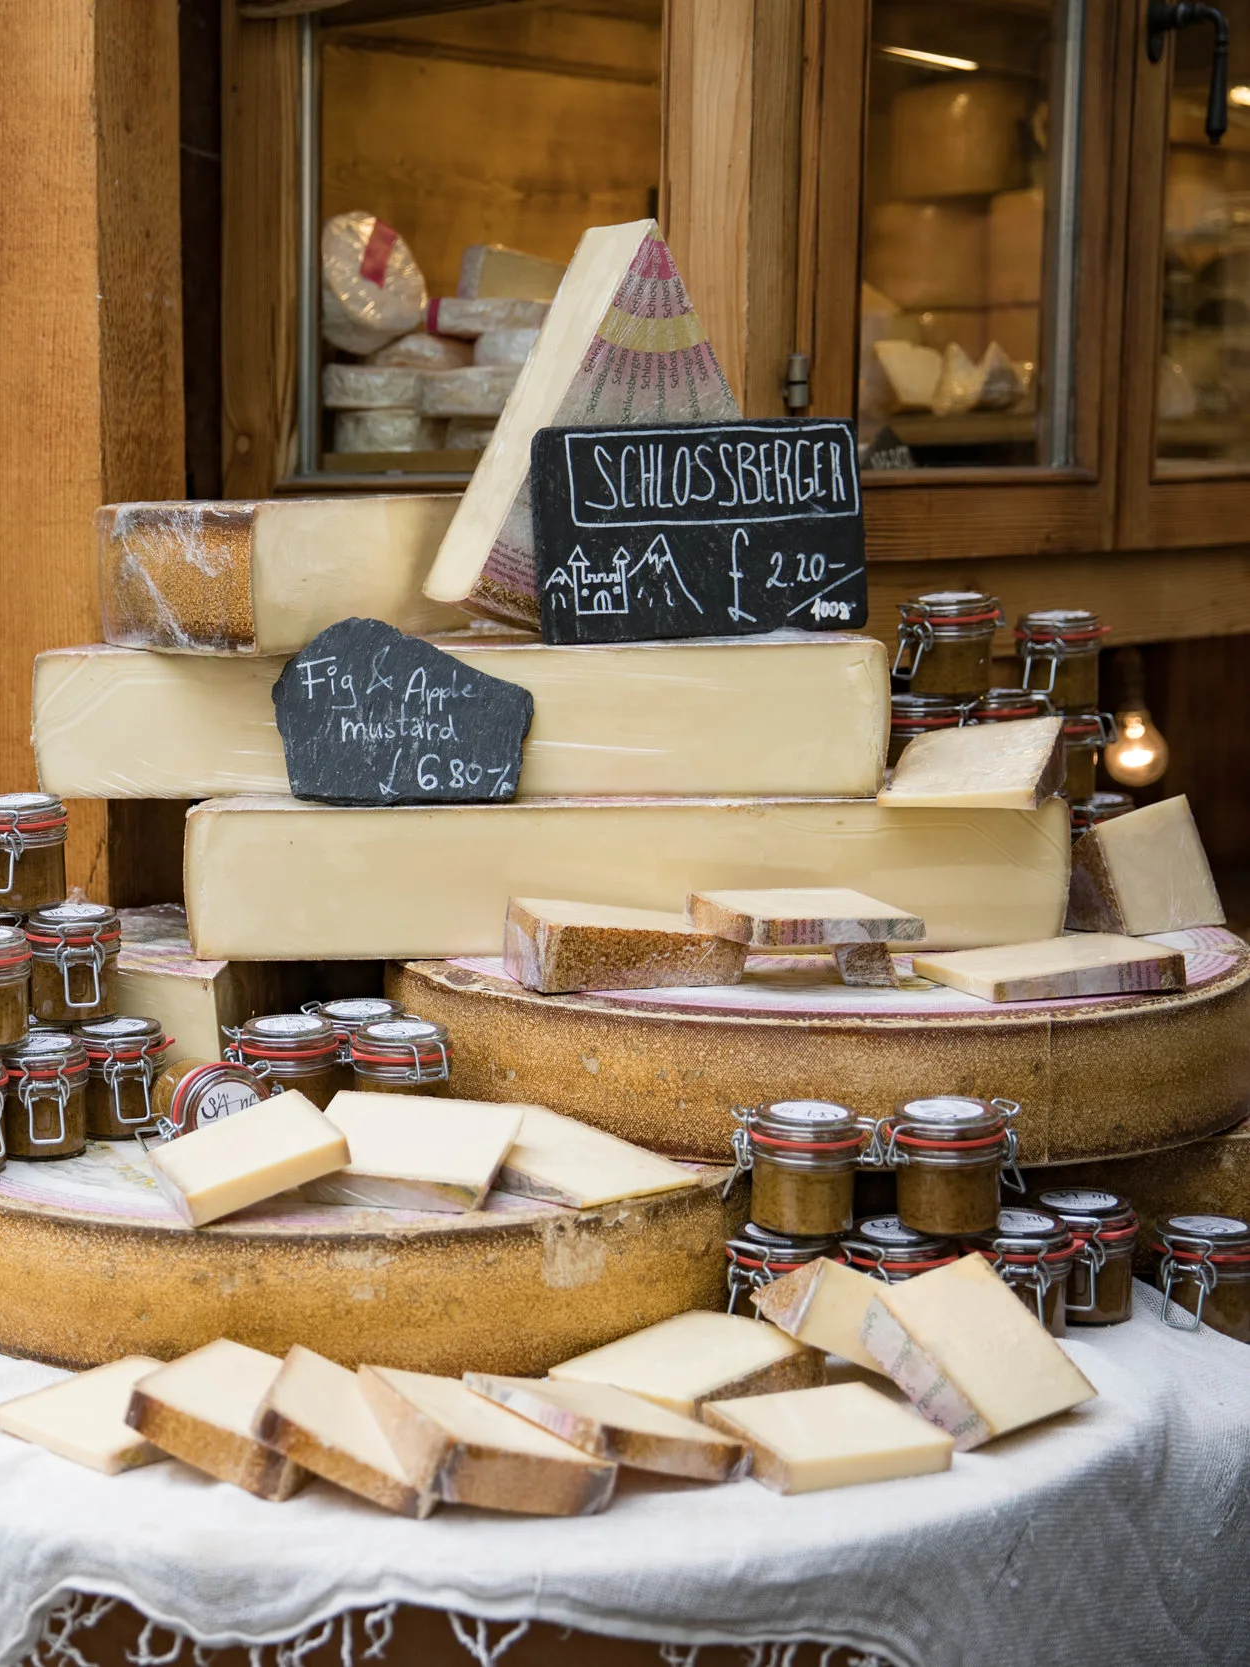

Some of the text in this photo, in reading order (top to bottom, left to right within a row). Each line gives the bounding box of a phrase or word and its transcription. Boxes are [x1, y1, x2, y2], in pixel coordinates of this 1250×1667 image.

[647, 281, 658, 319] Schloss
[662, 280, 673, 319] Schloss
[611, 347, 630, 386] Schloss
[641, 351, 653, 390] Schloss
[669, 351, 680, 389] Schloss
[585, 439, 847, 511] SCHLOSSBERGER
[296, 645, 479, 716] Fig & Apple
[341, 705, 459, 743] mustard
